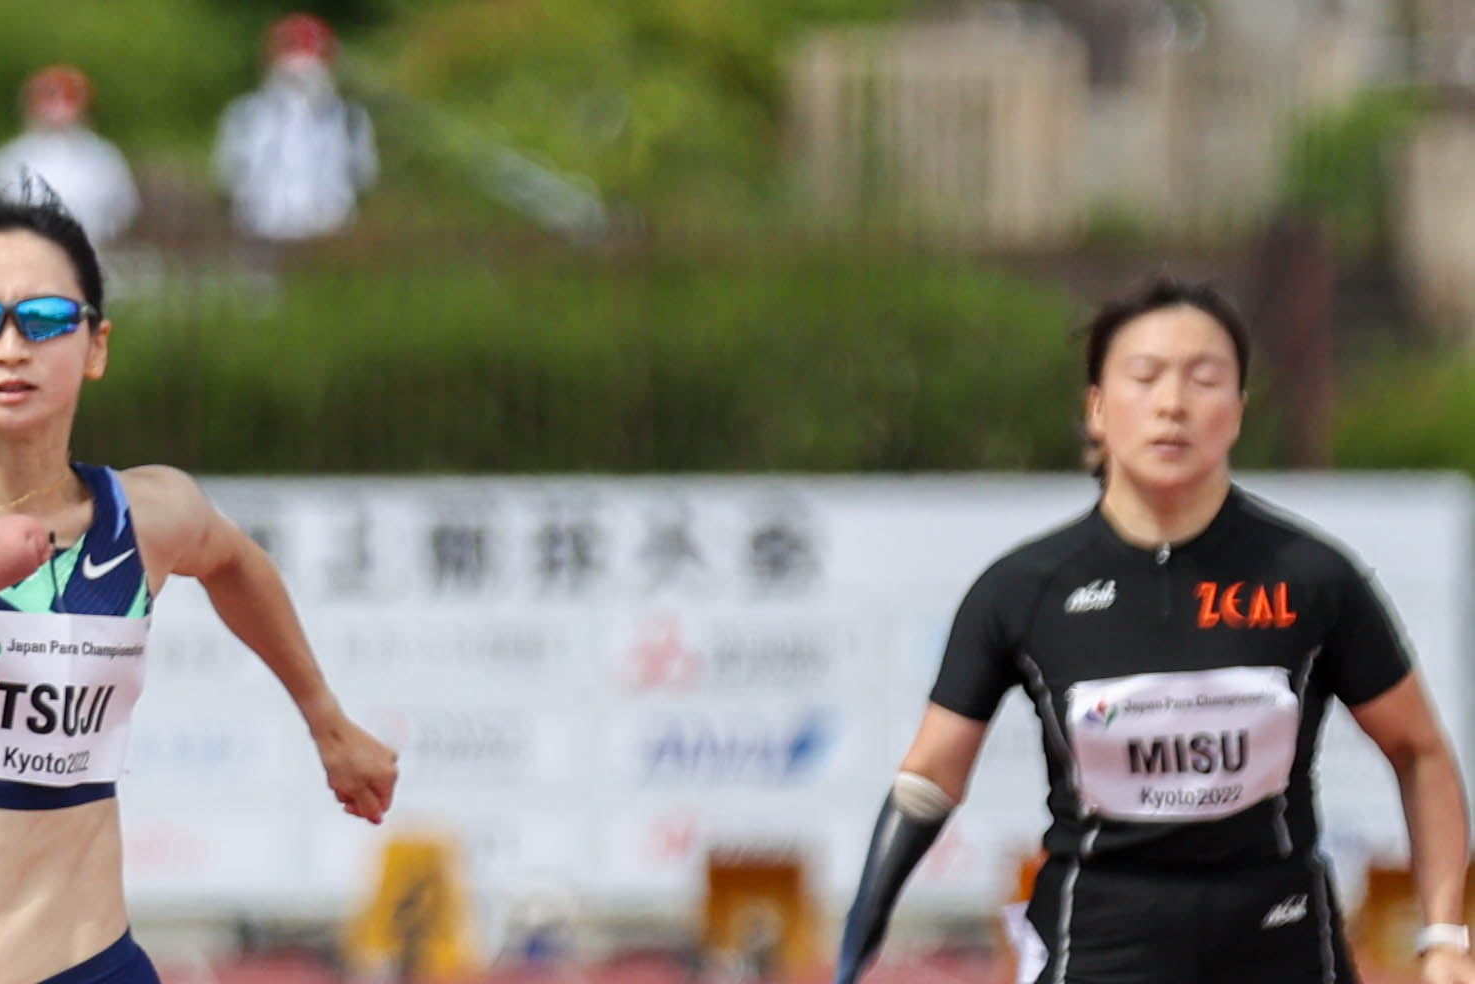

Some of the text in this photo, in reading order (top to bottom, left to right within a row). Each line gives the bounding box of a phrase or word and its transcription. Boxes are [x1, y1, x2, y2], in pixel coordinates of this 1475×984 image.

[1194, 581, 1297, 628] ZEAL
[7, 638, 46, 656] Japan
[50, 640, 79, 655] Para
[1127, 730, 1250, 774] MISU
